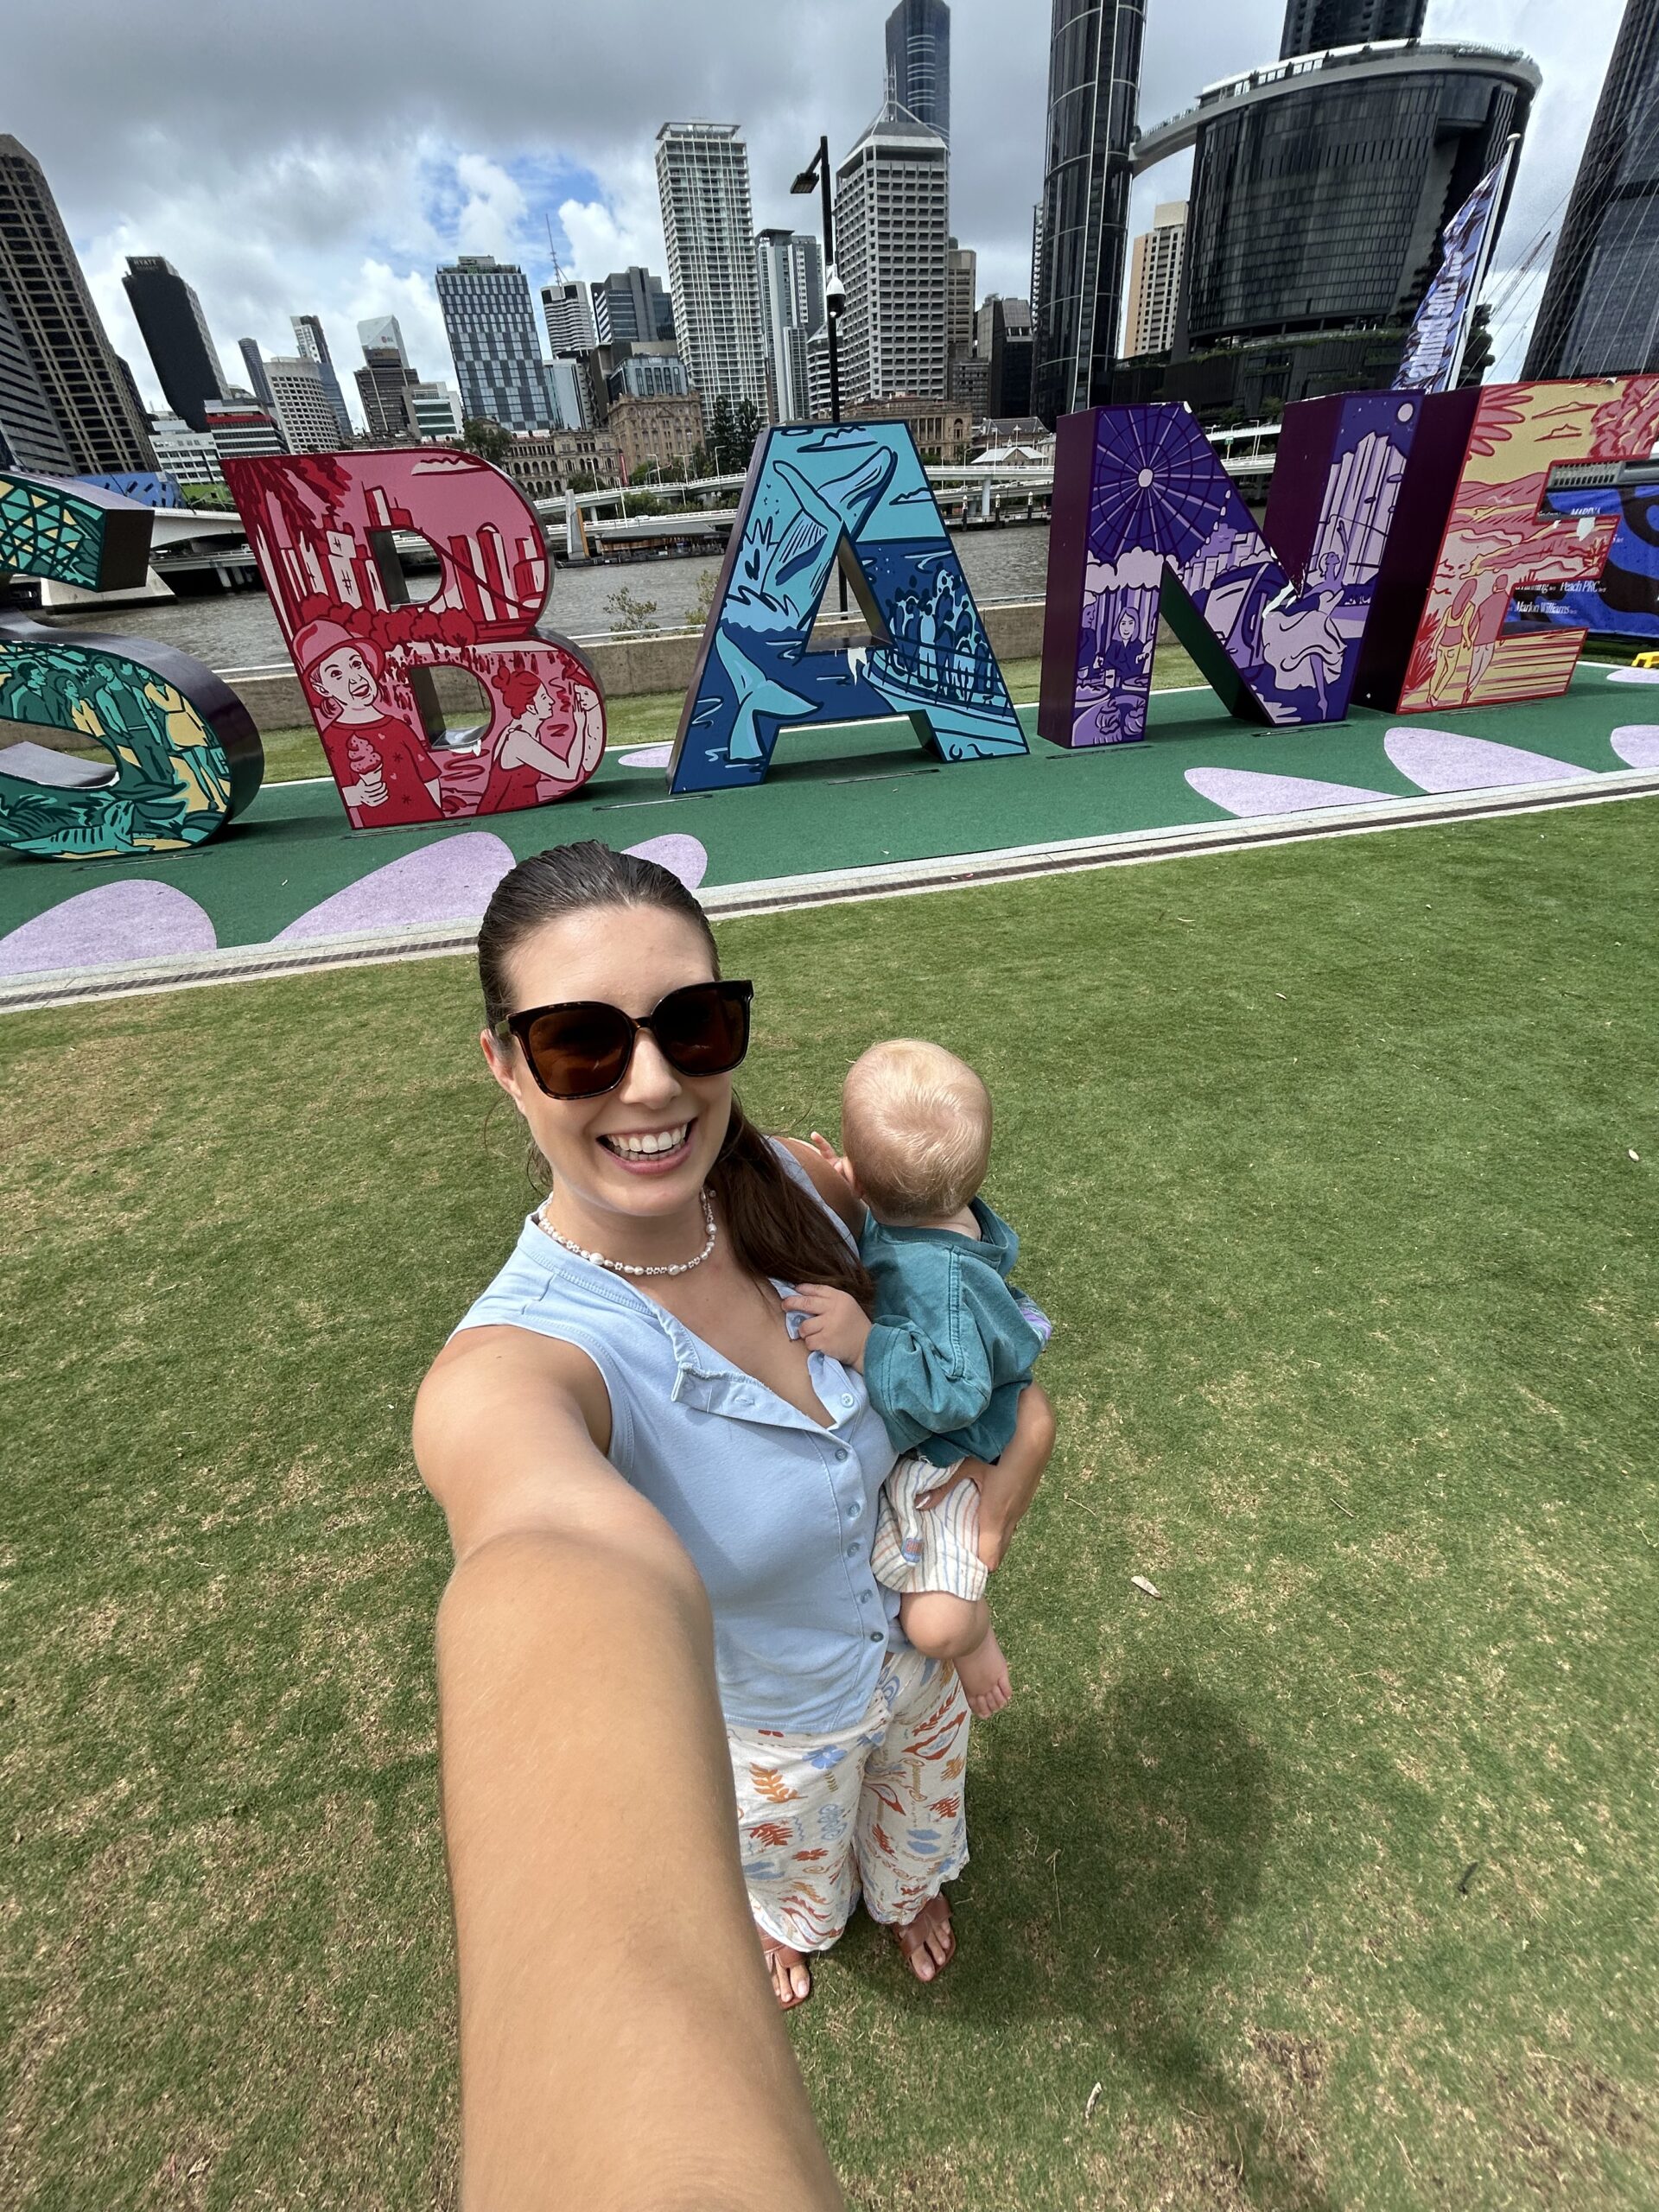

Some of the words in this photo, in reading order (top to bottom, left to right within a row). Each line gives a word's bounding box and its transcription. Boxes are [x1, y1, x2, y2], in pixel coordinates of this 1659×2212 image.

[1582, 581, 1599, 593] PRC
[1515, 601, 1539, 613] Marlon
[1540, 602, 1571, 614] Williams
